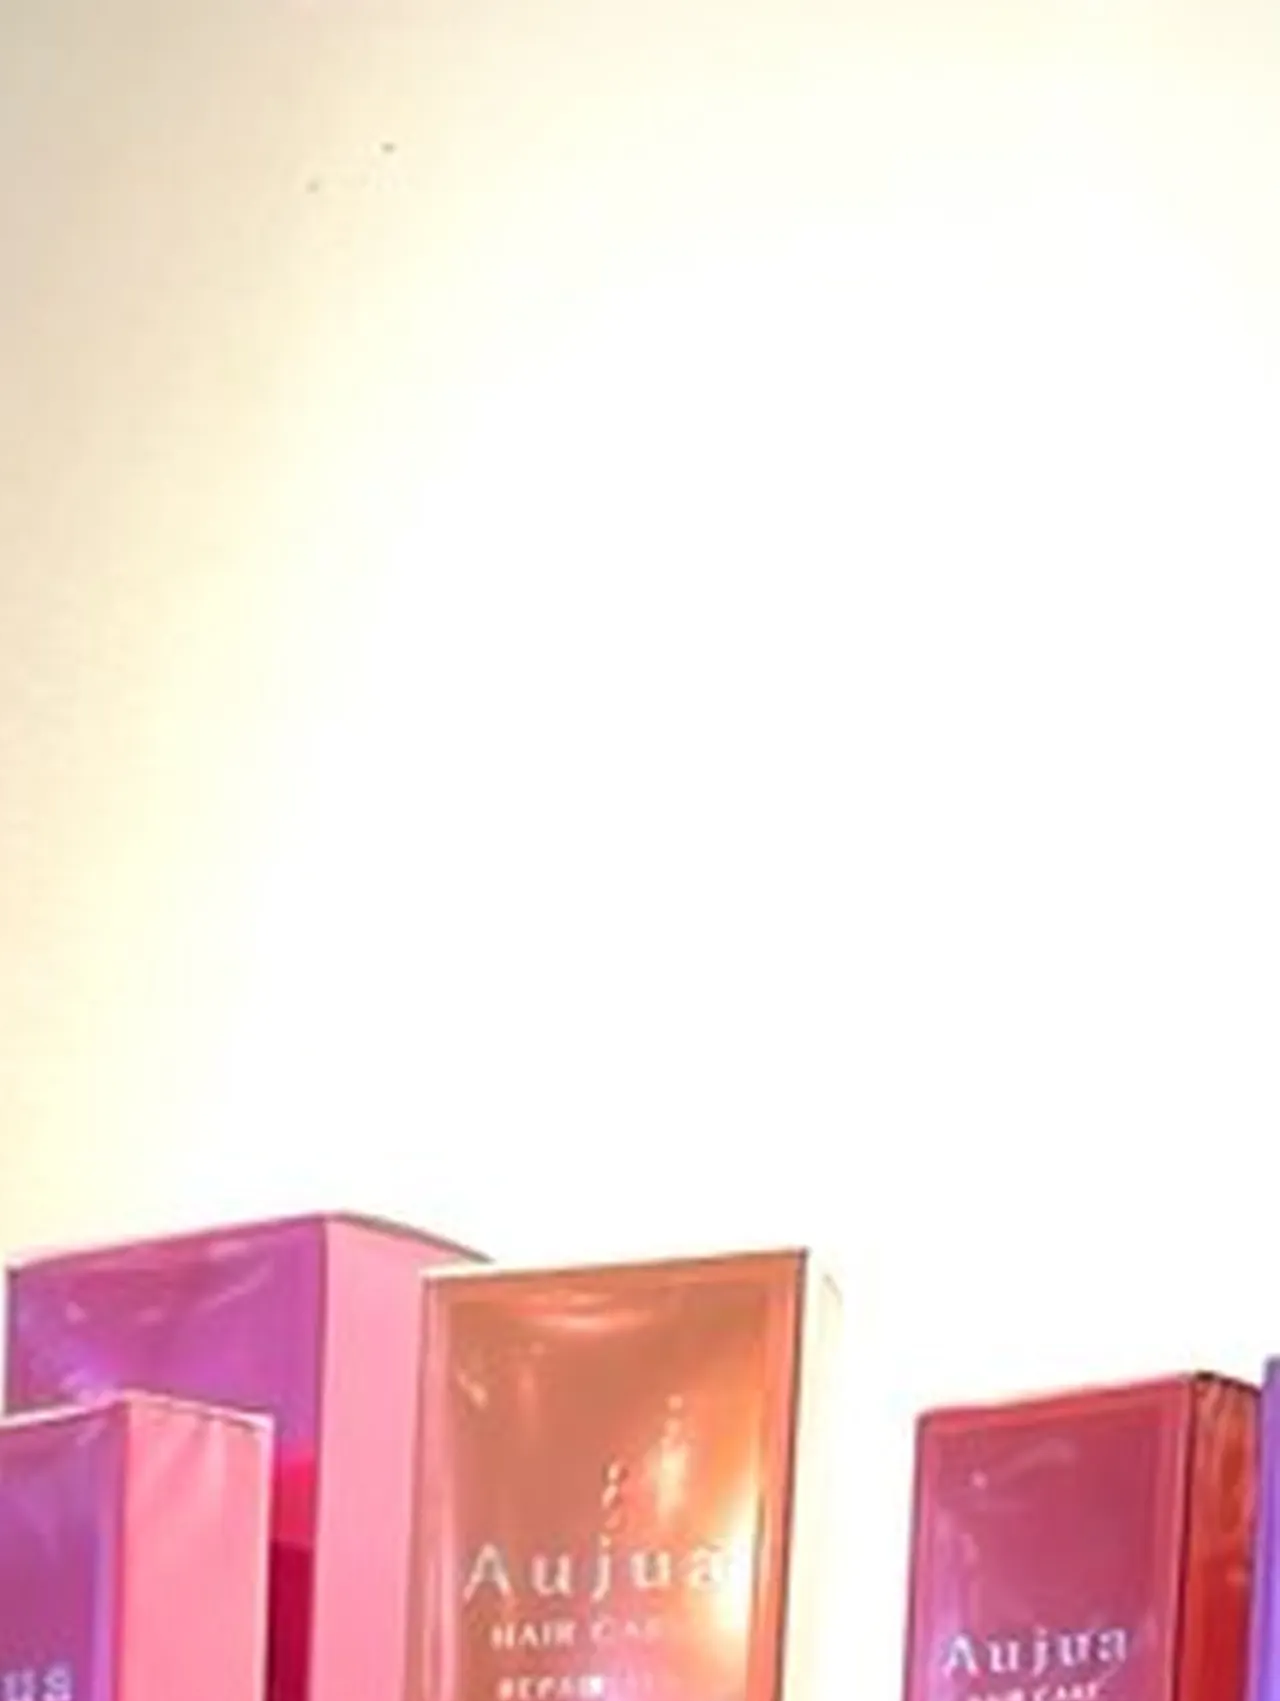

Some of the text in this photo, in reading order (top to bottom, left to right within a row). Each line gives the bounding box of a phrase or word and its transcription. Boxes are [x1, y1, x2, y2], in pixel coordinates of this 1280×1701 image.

[462, 1535, 732, 1603] Aujua
[491, 1620, 577, 1649] HAIR
[941, 1626, 1129, 1680] Aujua
